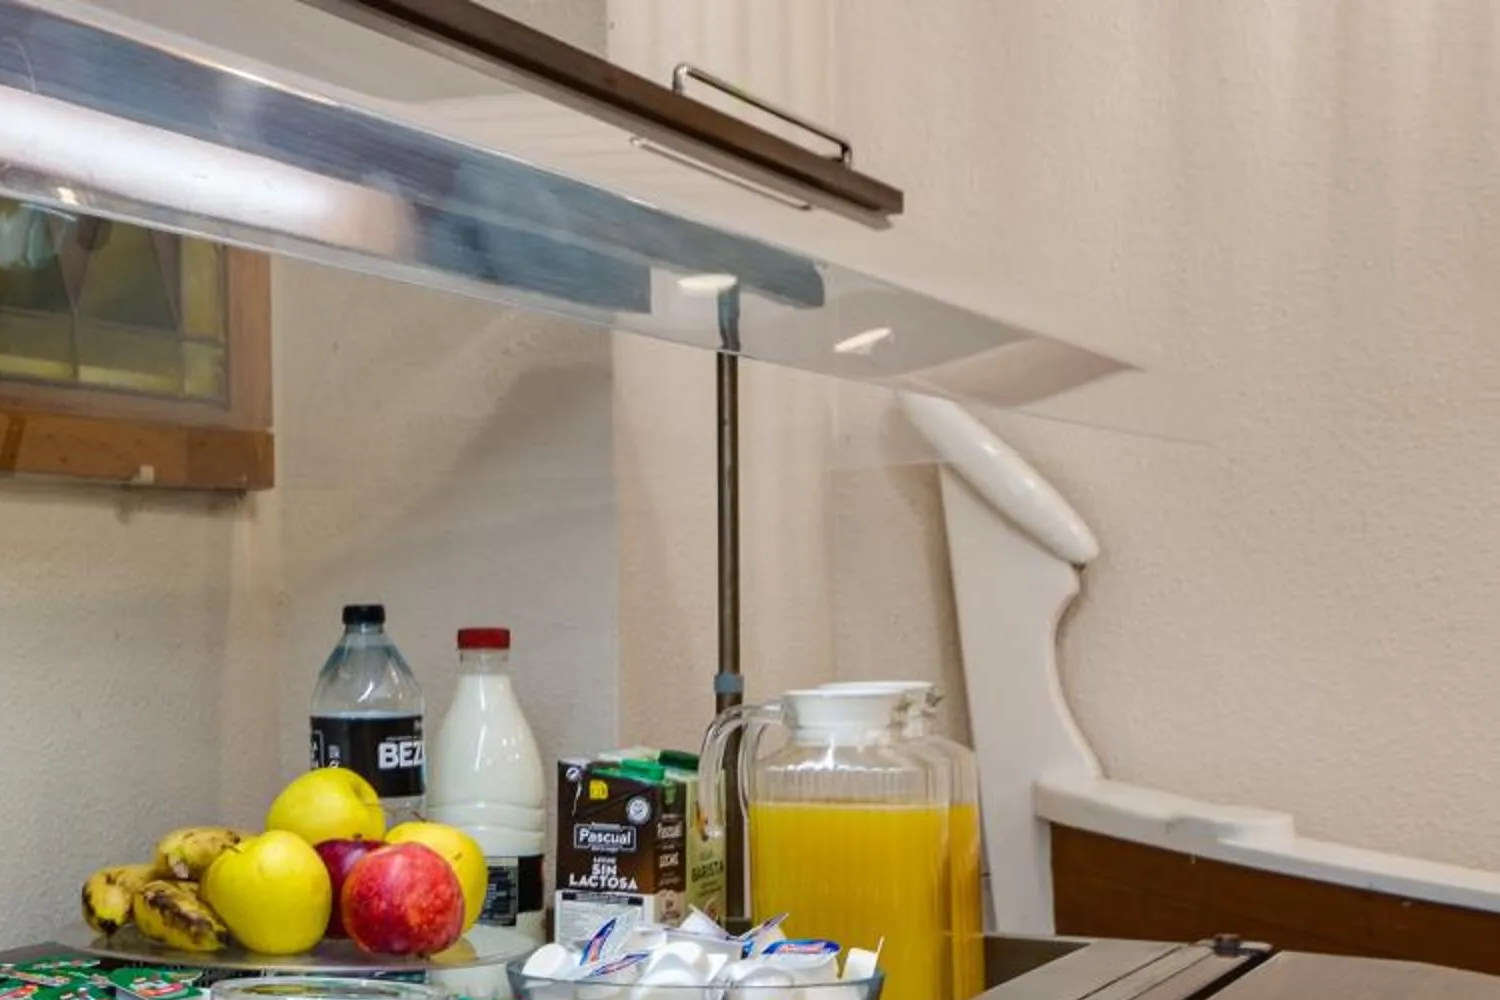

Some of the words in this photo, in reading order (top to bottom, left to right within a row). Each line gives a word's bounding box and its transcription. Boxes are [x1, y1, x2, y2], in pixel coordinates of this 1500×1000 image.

[579, 827, 631, 845] Pascual
[592, 863, 617, 876] SIN
[569, 873, 638, 891] LACTOSA
